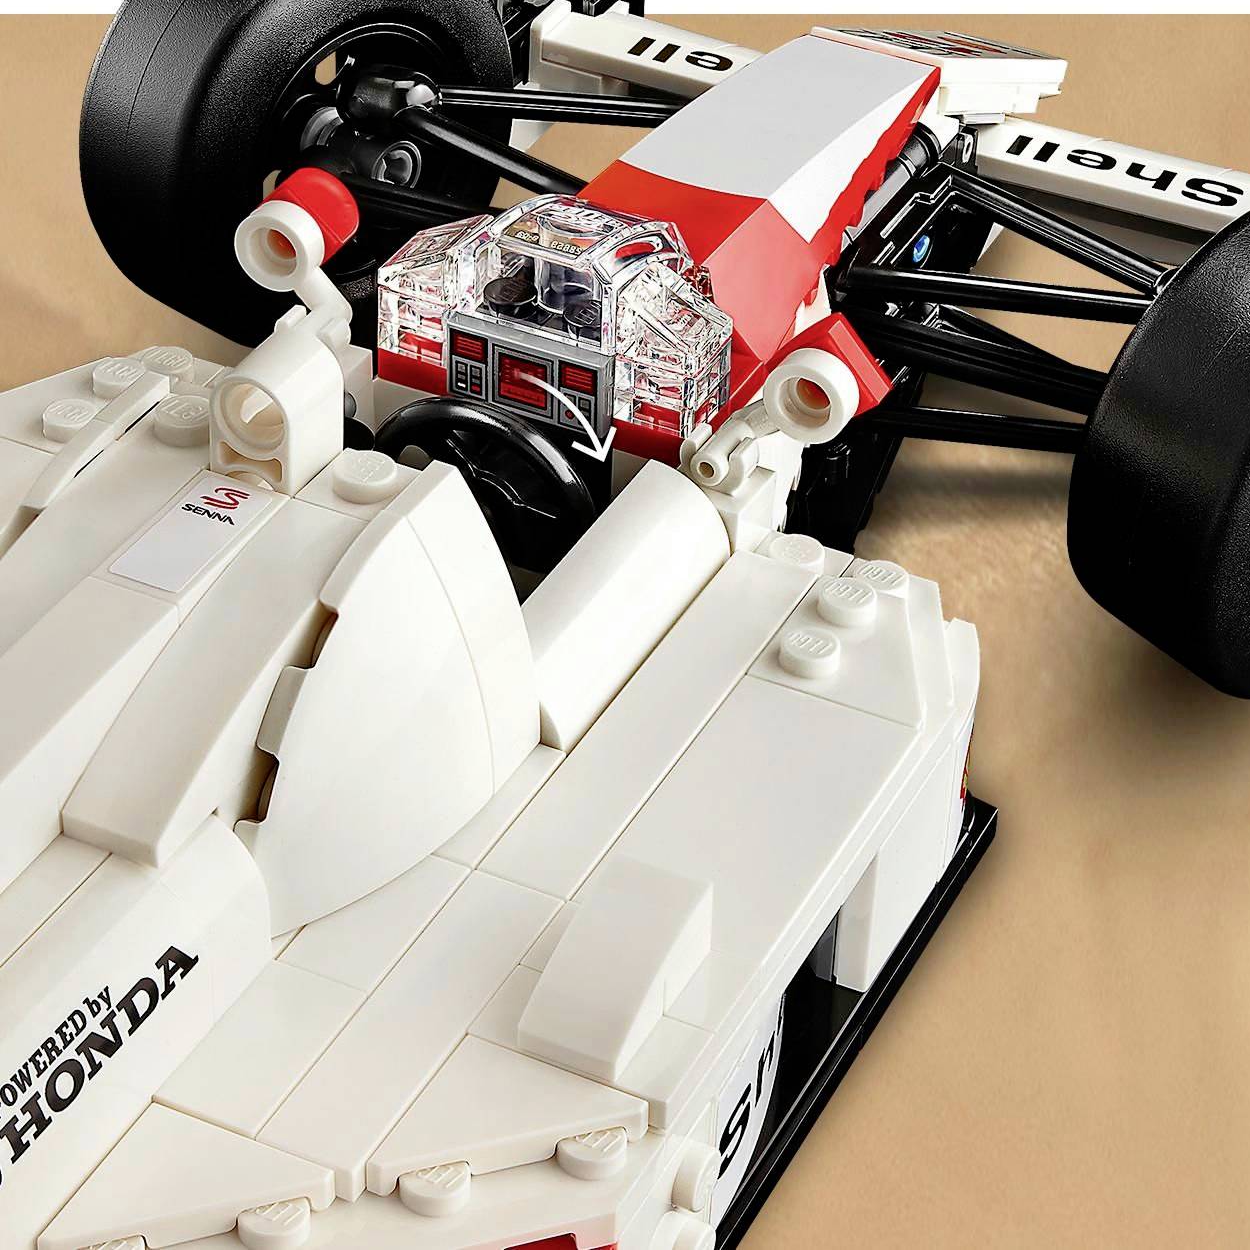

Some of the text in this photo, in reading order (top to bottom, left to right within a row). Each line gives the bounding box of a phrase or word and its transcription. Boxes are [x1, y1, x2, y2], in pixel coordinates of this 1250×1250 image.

[627, 36, 734, 71] ell
[1006, 134, 1244, 207] Shell
[181, 503, 235, 526] SENNA
[0, 985, 112, 1118] OWERED by
[0, 945, 199, 1165] HONDA
